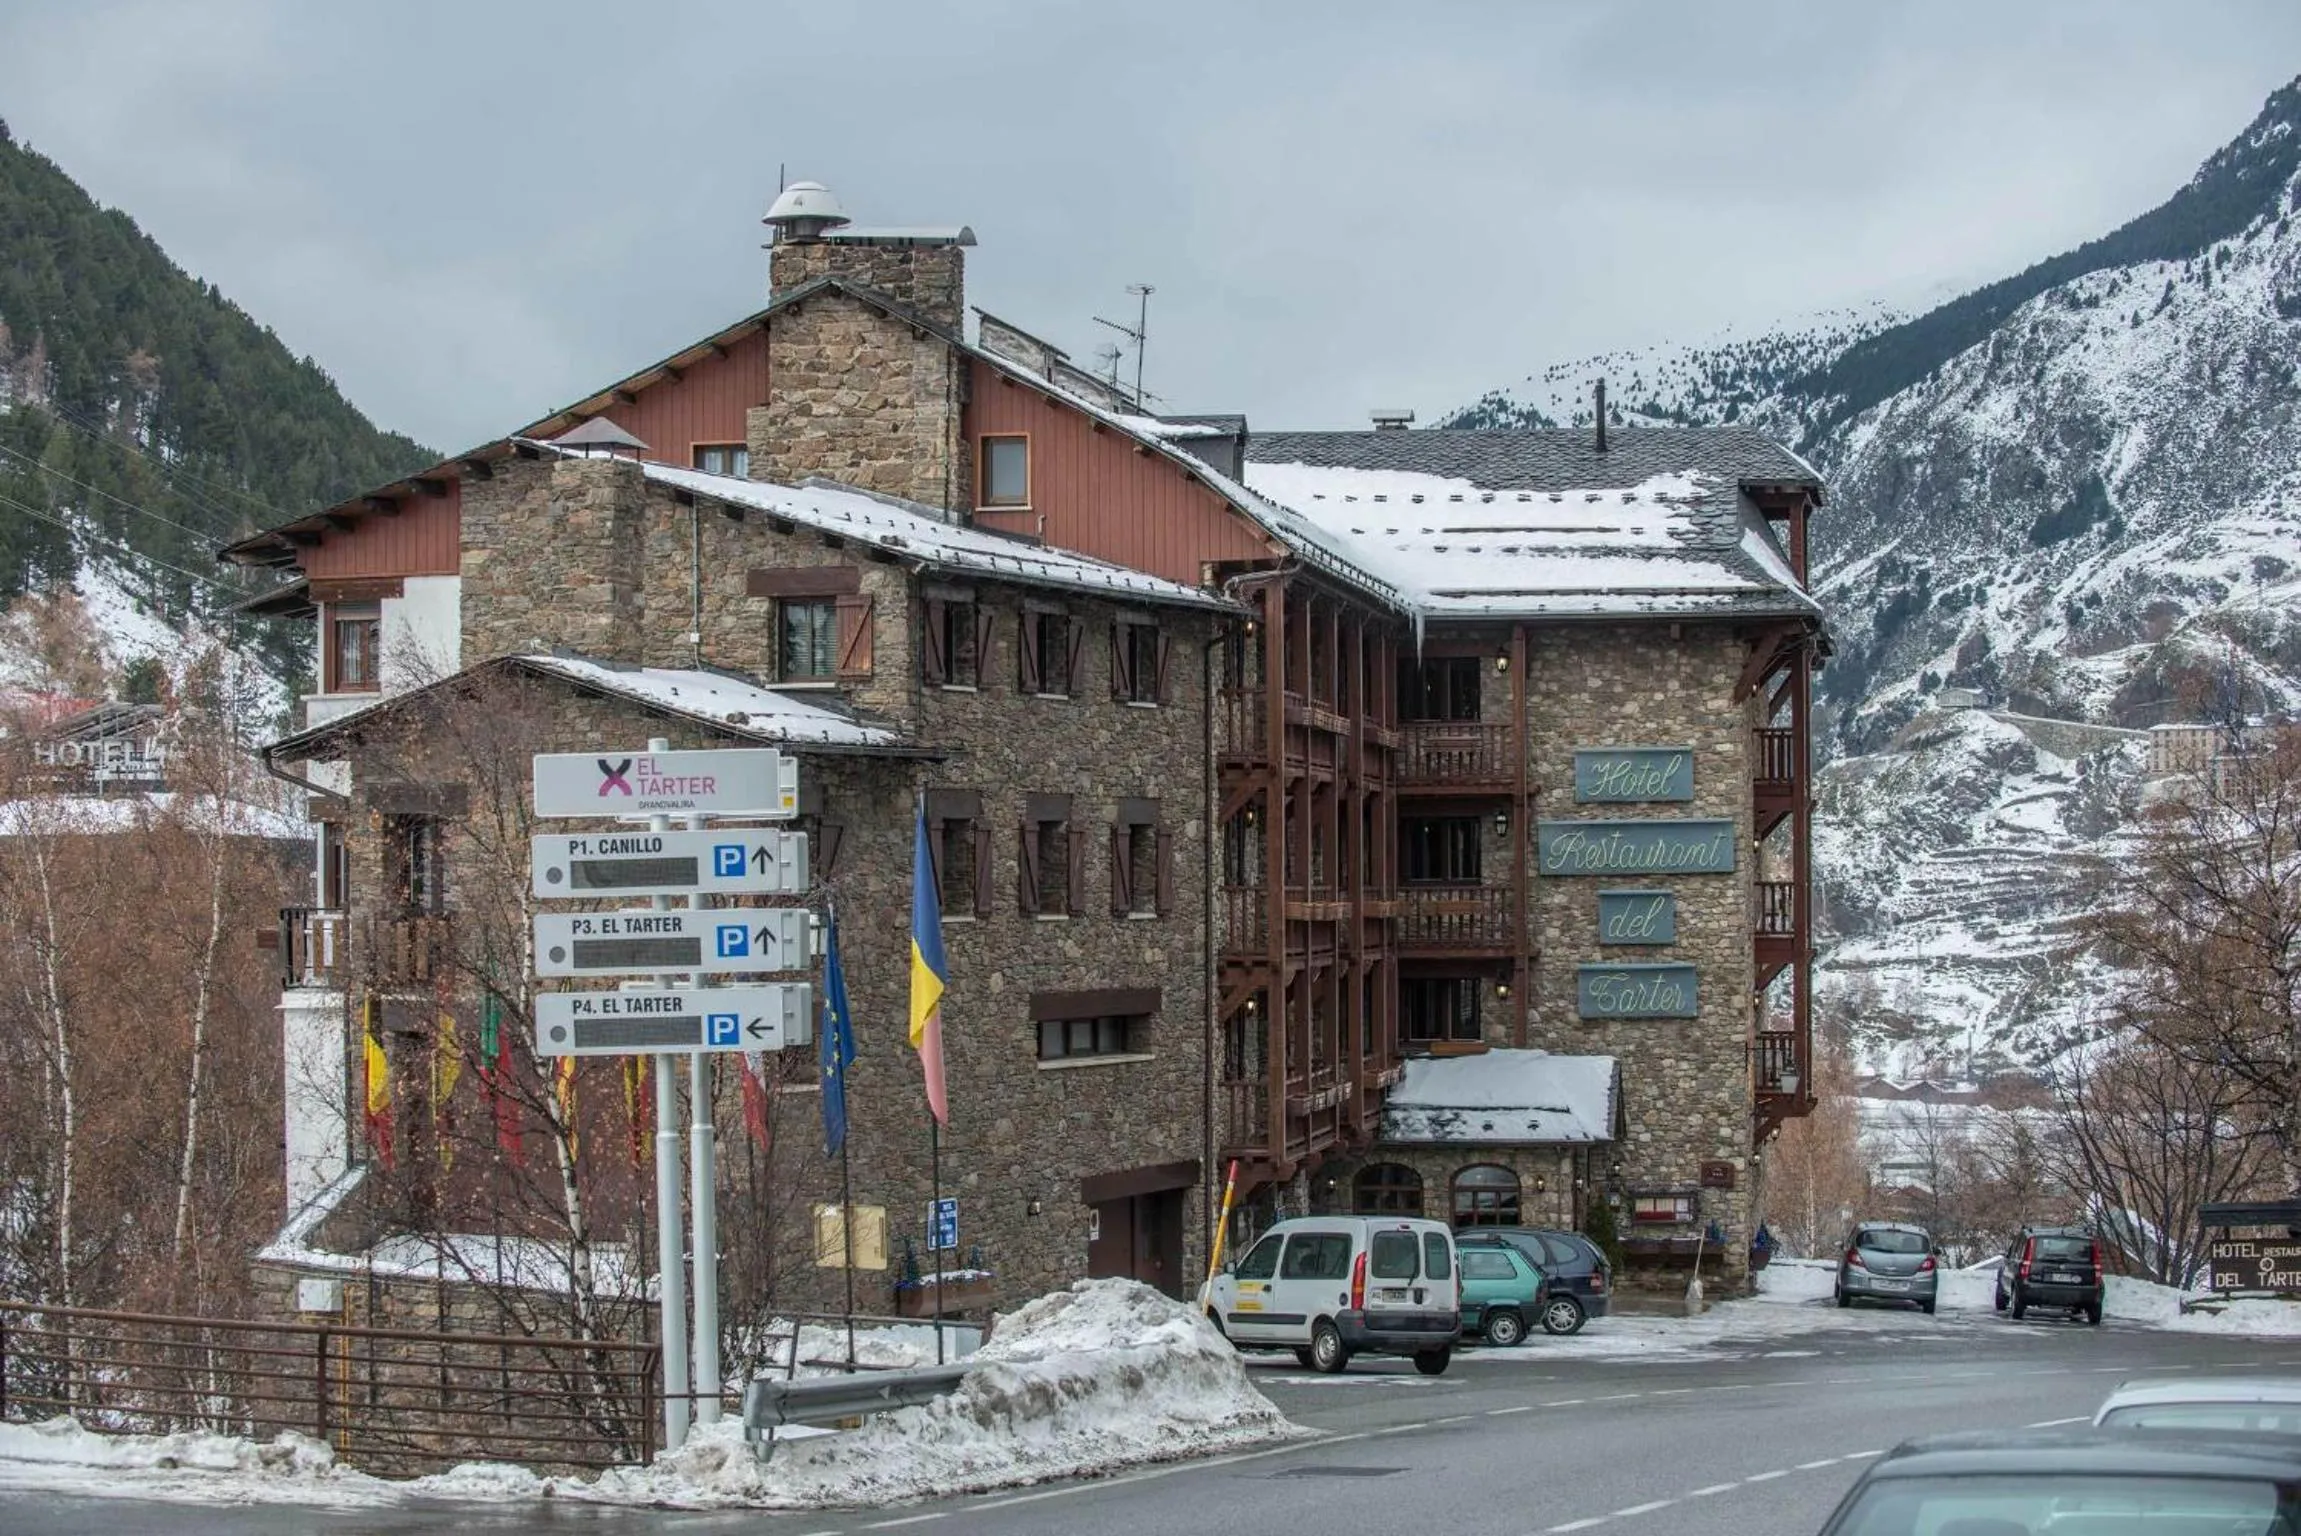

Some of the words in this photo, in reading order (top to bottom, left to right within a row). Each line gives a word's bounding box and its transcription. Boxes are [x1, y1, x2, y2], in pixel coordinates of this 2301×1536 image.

[34, 740, 139, 767] HOTEL
[637, 757, 663, 776] EL
[1586, 754, 1682, 797] Hotel
[637, 777, 716, 795] TARTER
[569, 840, 594, 855] P1.
[599, 838, 662, 854] CANILLO
[1547, 830, 1727, 870] Restaurant
[720, 850, 741, 874] P
[572, 919, 597, 935] P3.
[602, 919, 620, 933] EL
[624, 917, 682, 933] TARTER
[1608, 895, 1665, 938] del
[723, 930, 744, 954] P
[1589, 973, 1686, 1013] Tarter
[572, 1000, 597, 1015] P4.
[602, 998, 620, 1013] EL
[624, 997, 682, 1013] TARTER
[714, 1019, 735, 1043] P
[2212, 1243, 2260, 1258] HOTEL
[2216, 1273, 2245, 1288] DEL
